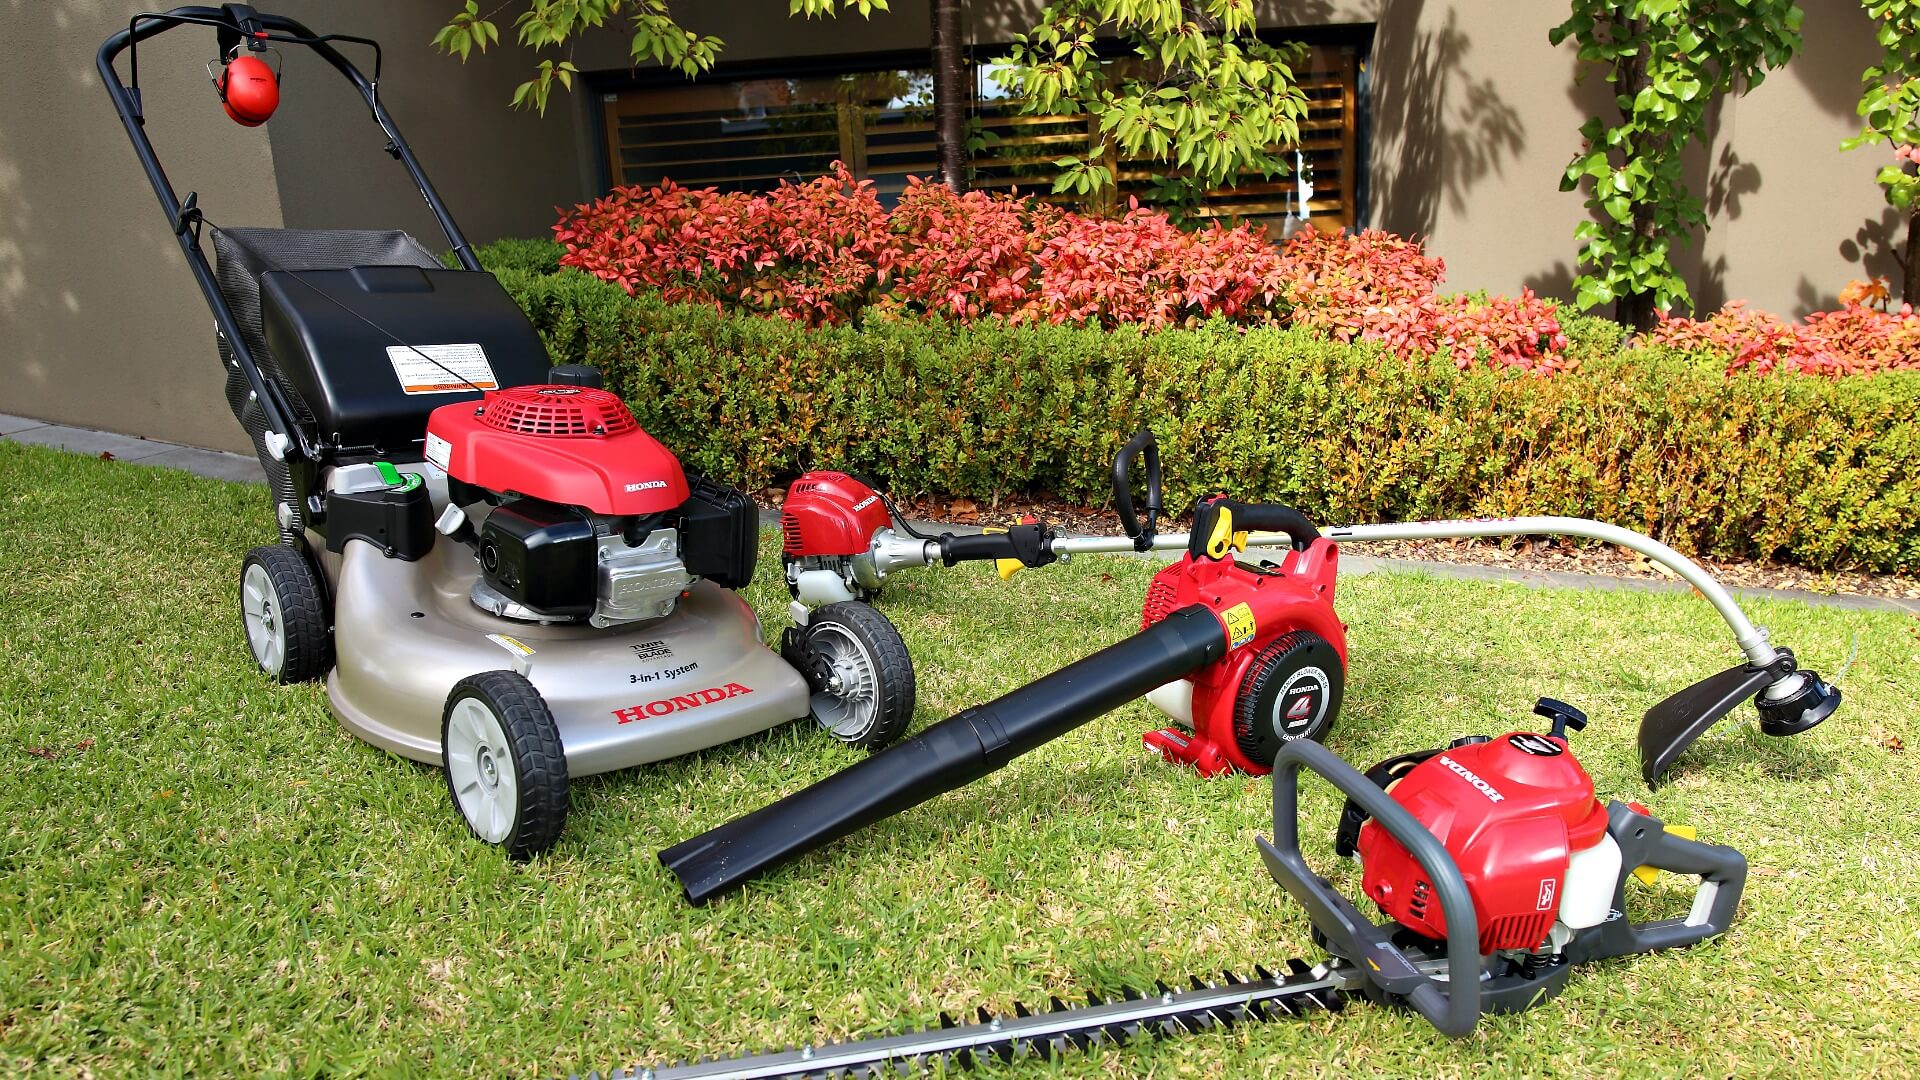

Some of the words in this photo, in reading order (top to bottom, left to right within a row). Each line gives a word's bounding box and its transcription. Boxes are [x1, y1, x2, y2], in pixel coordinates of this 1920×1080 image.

[623, 480, 668, 493] HONDA
[852, 495, 879, 512] HONDA
[629, 640, 665, 649] TWIN
[638, 648, 672, 660] BLADE
[629, 671, 661, 684] 3-in-1
[664, 661, 698, 680] System
[1289, 684, 1320, 695] HONDA
[611, 682, 754, 725] HONDA
[1286, 694, 1312, 720] 4
[1439, 755, 1505, 804] HONDA
